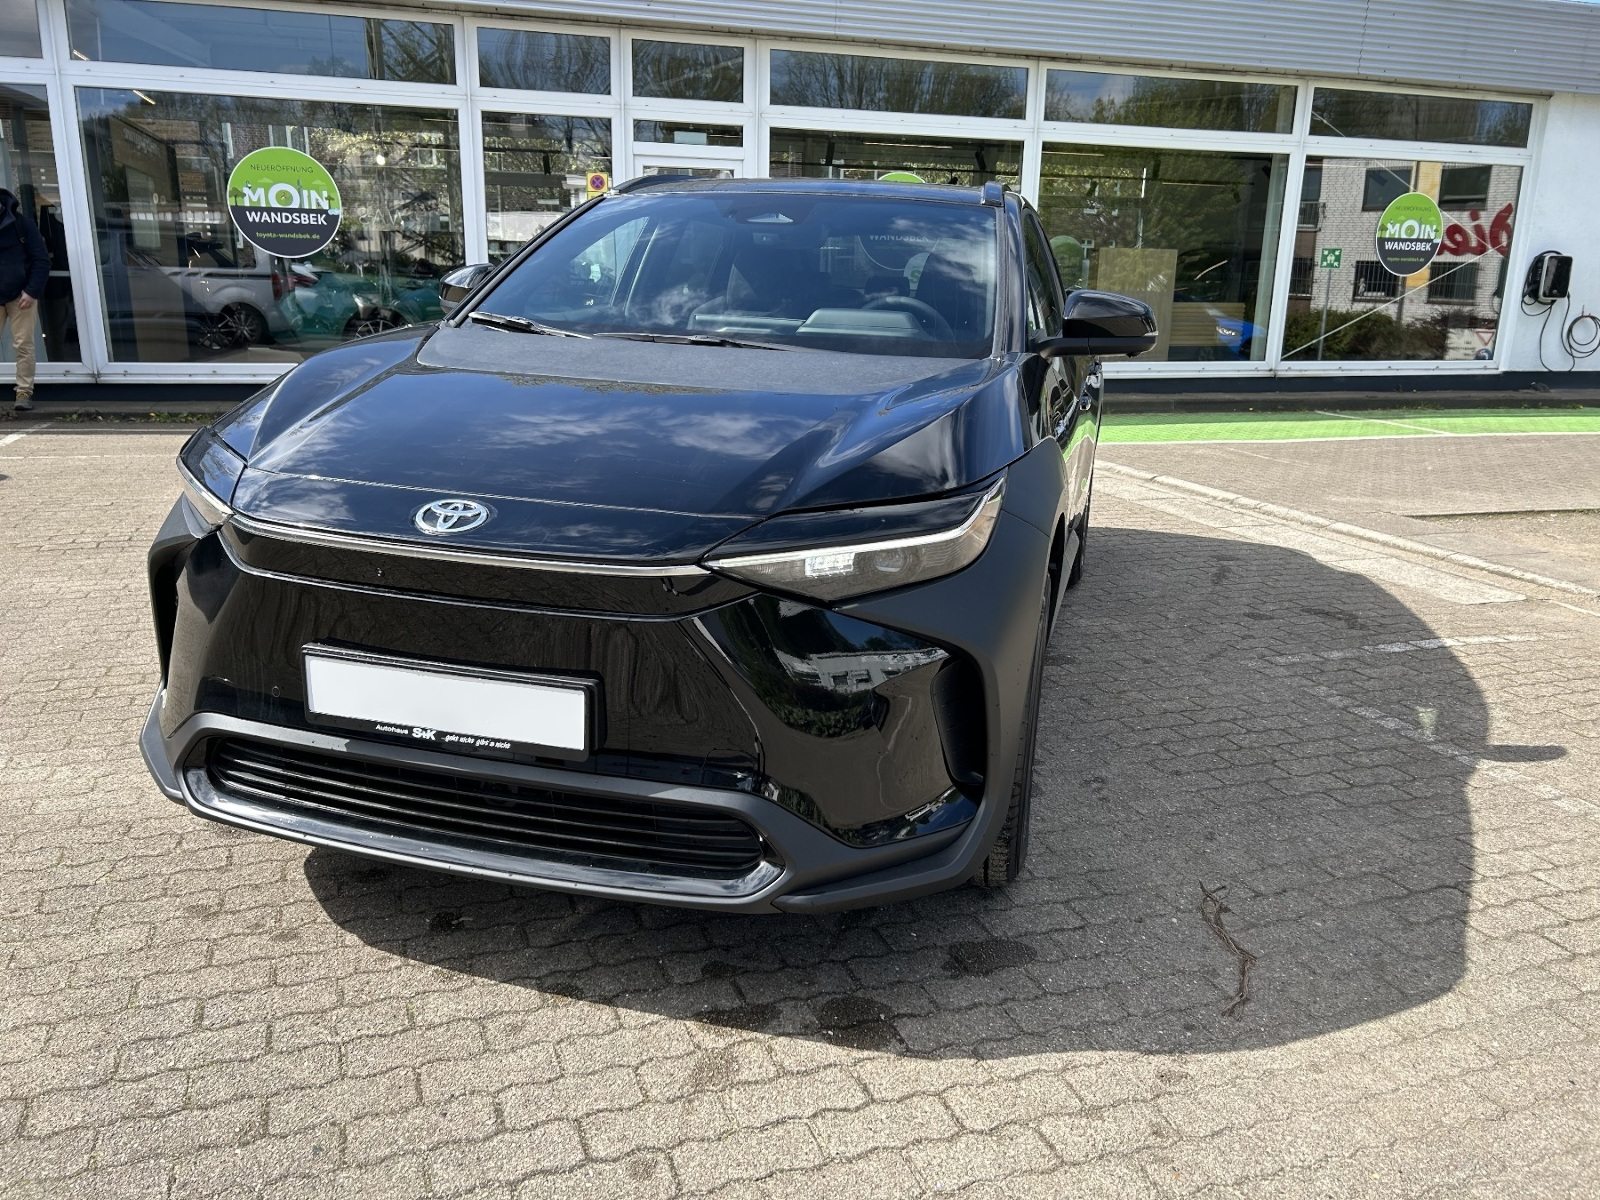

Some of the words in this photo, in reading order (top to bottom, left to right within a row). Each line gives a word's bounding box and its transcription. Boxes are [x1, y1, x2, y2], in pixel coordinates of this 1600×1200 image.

[242, 182, 329, 210] MOIN
[246, 210, 328, 226] WANDSBEK
[1386, 219, 1437, 239] MOIN
[1385, 241, 1432, 251] WANDSBEK
[375, 724, 409, 735] Autohaus
